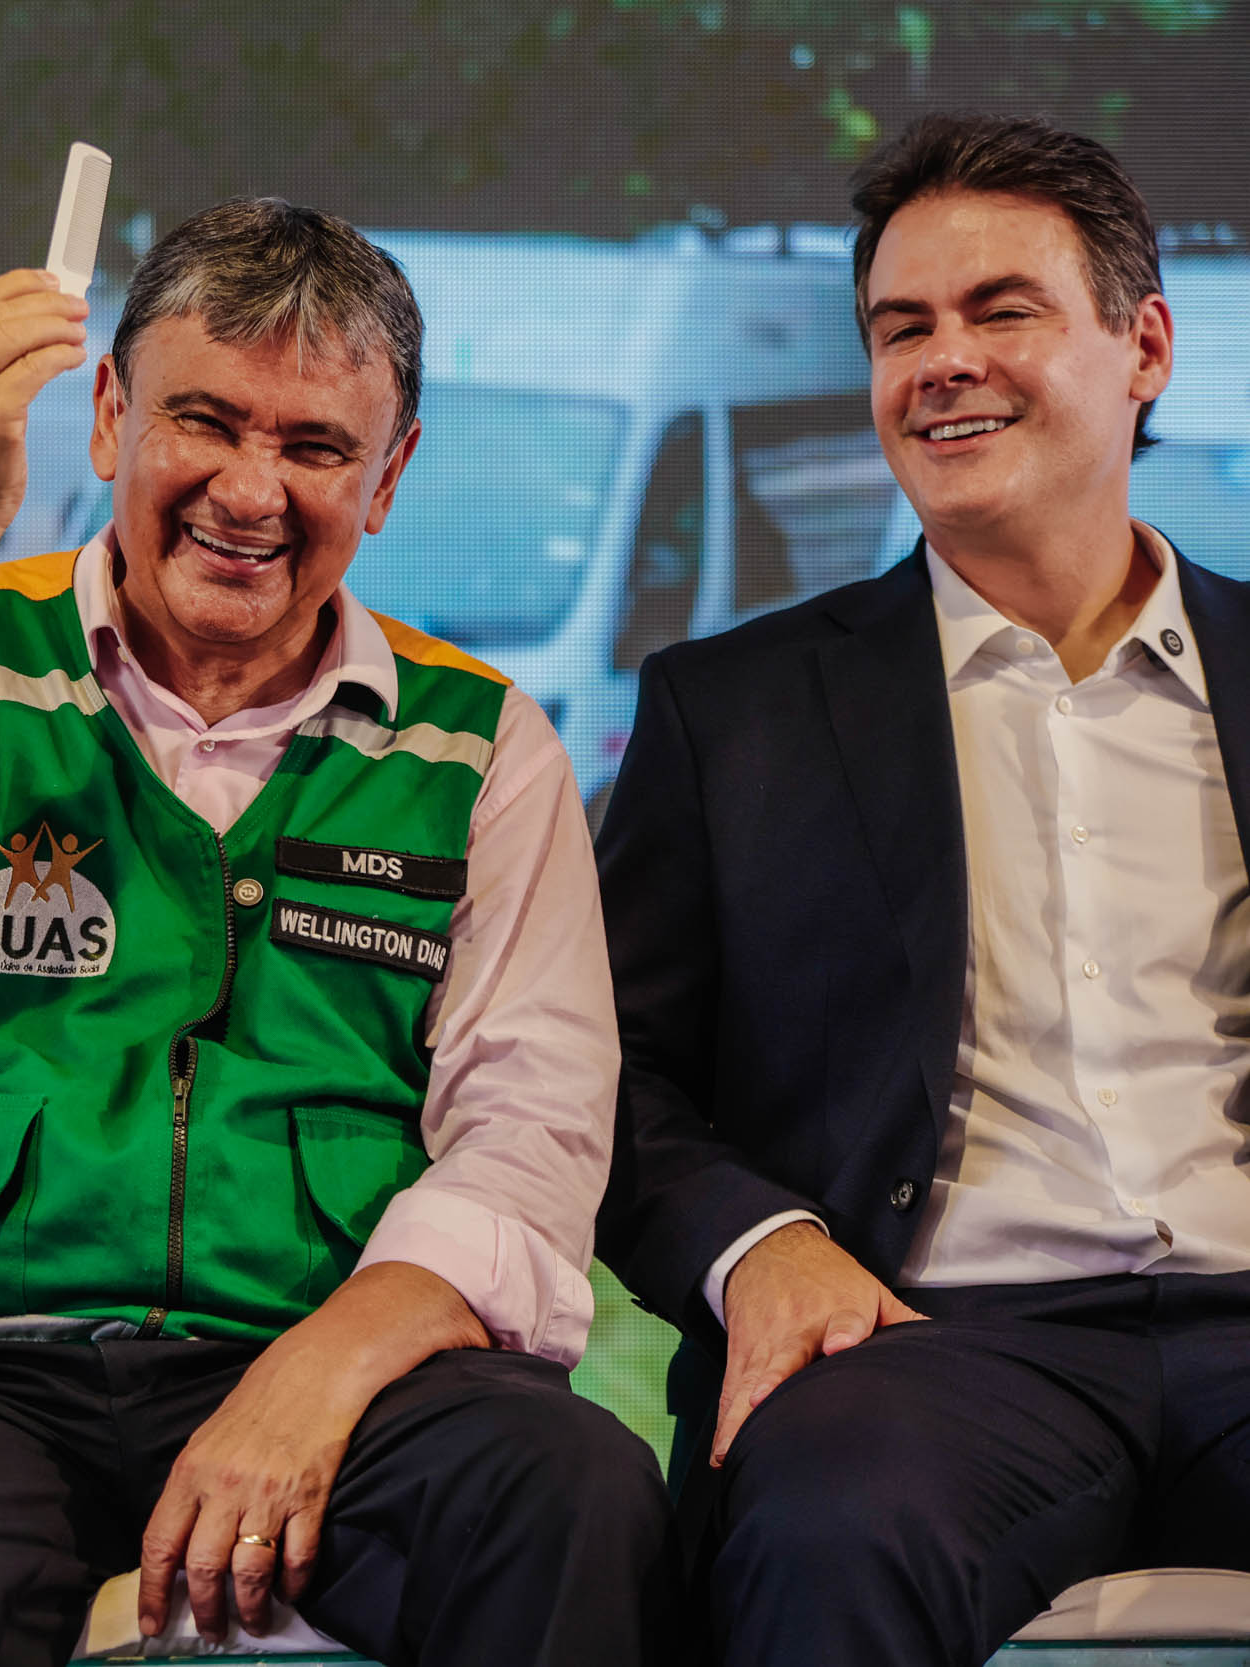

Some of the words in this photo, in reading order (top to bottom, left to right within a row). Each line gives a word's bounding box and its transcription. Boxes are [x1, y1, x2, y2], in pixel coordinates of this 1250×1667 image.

[342, 851, 403, 880] MDS
[280, 907, 413, 961] WELLINGTON
[417, 938, 447, 971] DIAS
[23, 962, 33, 972] de
